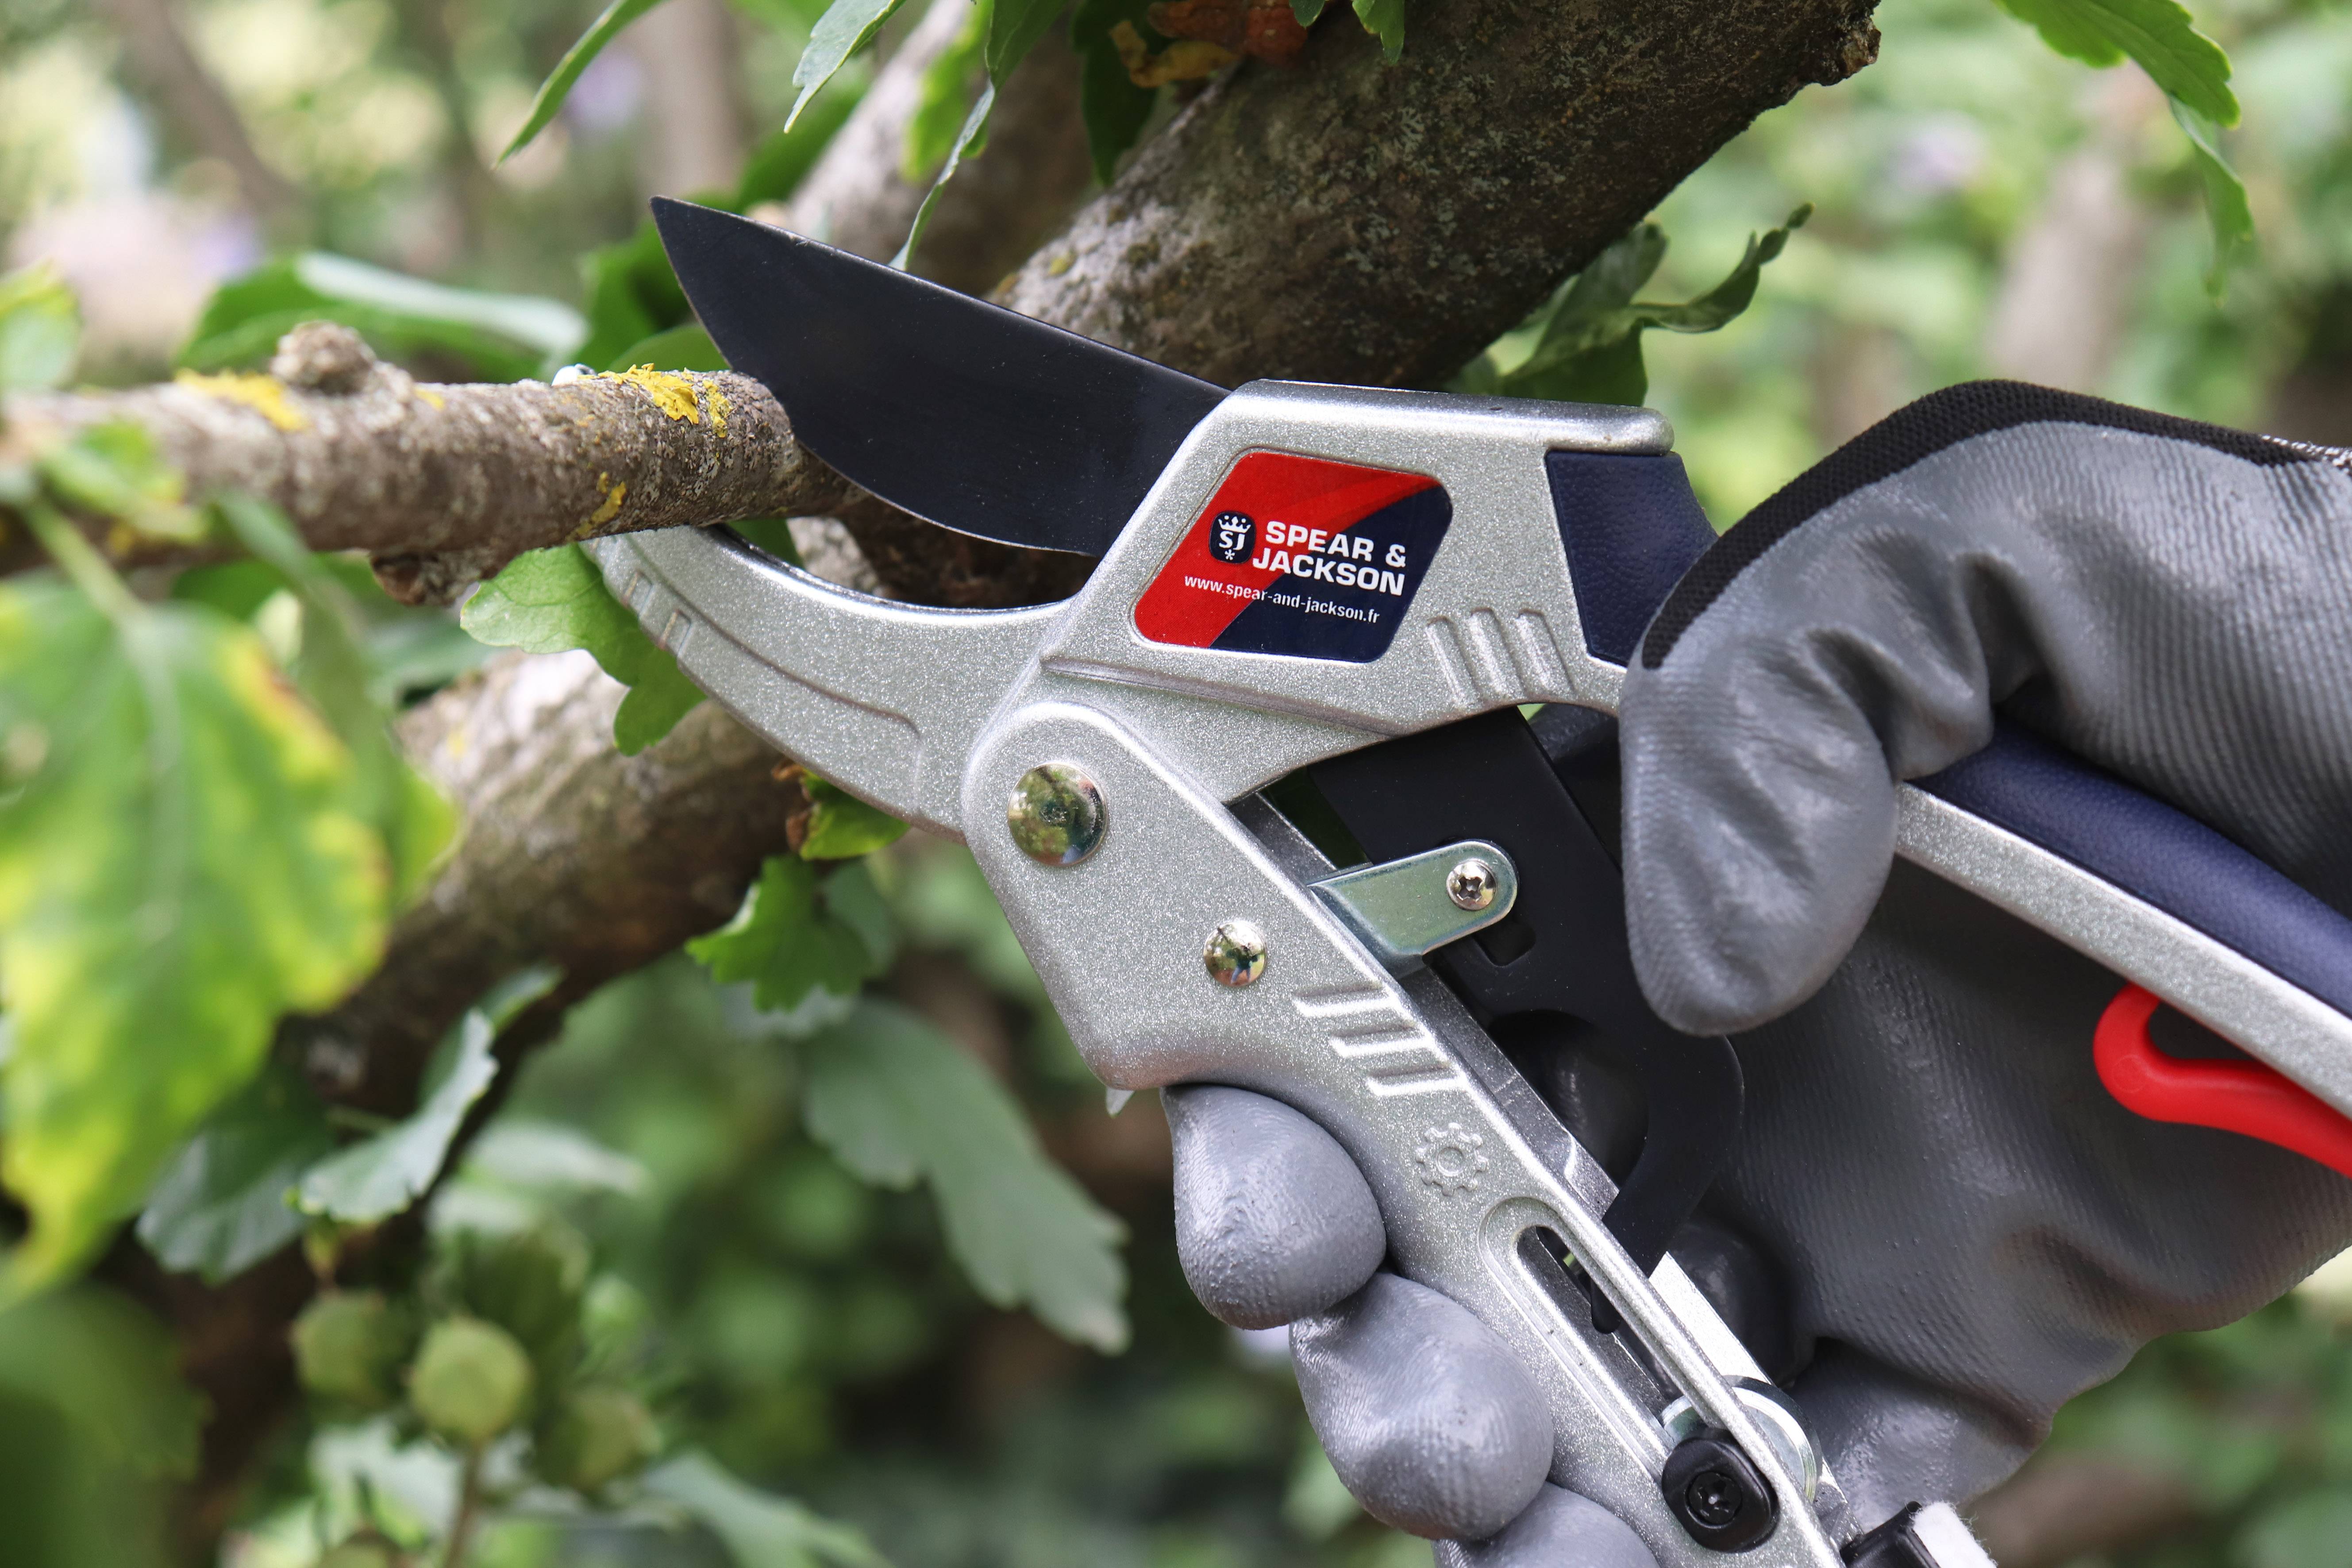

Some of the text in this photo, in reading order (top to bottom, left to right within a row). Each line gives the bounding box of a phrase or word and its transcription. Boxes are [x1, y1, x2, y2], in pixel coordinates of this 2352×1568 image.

[1265, 520, 1406, 568] SPEAR &
[1252, 547, 1405, 596] JACKSON
[1184, 575, 1380, 624] www.spear-and-jackson.fr
